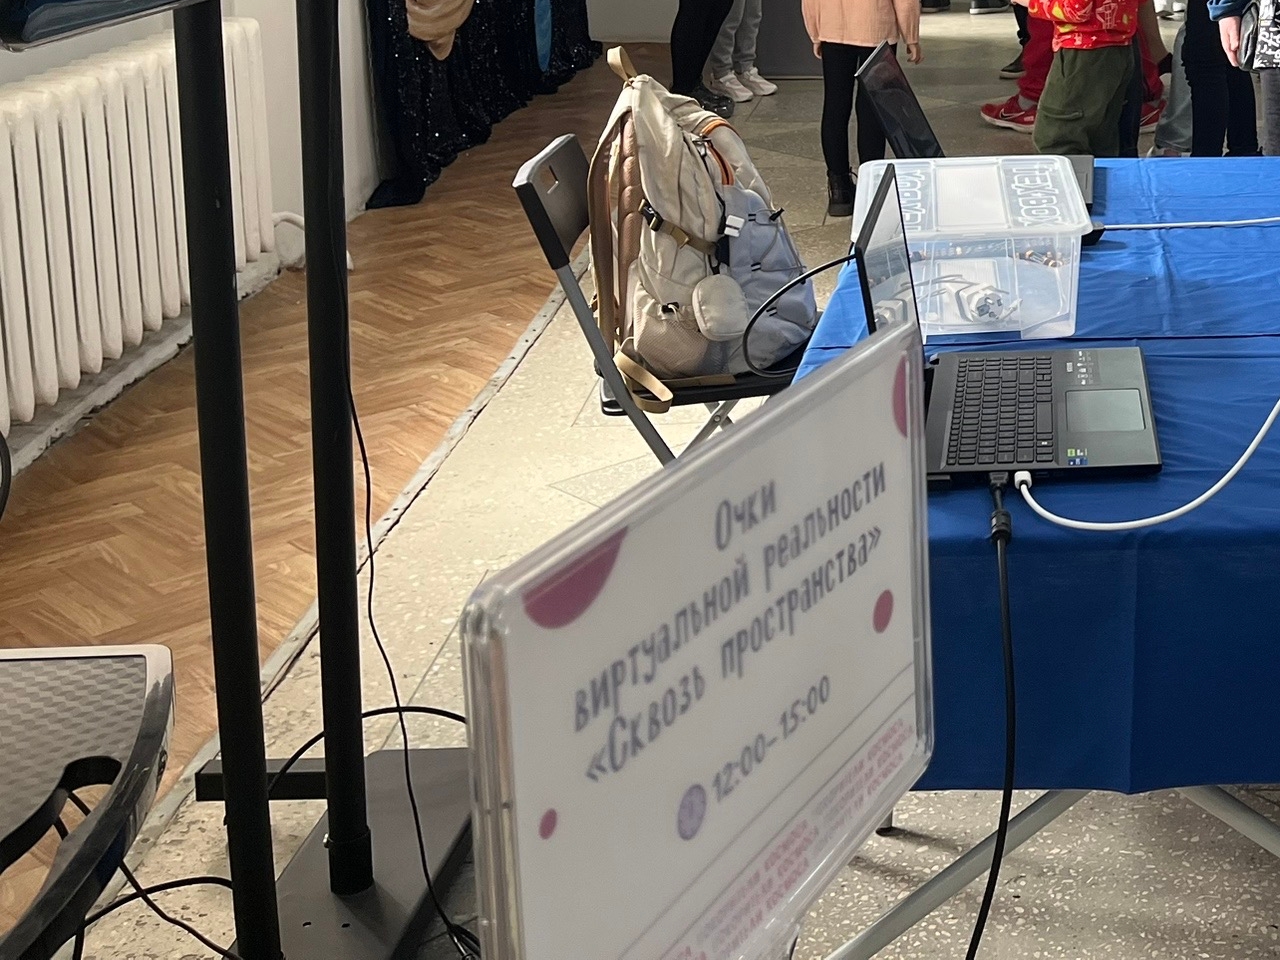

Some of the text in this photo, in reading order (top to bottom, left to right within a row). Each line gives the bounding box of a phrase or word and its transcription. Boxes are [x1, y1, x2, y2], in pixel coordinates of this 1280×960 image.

[575, 461, 886, 733] виртуальной реальности
[715, 480, 777, 552] Очки
[586, 526, 882, 782] «Сквозь пространства»
